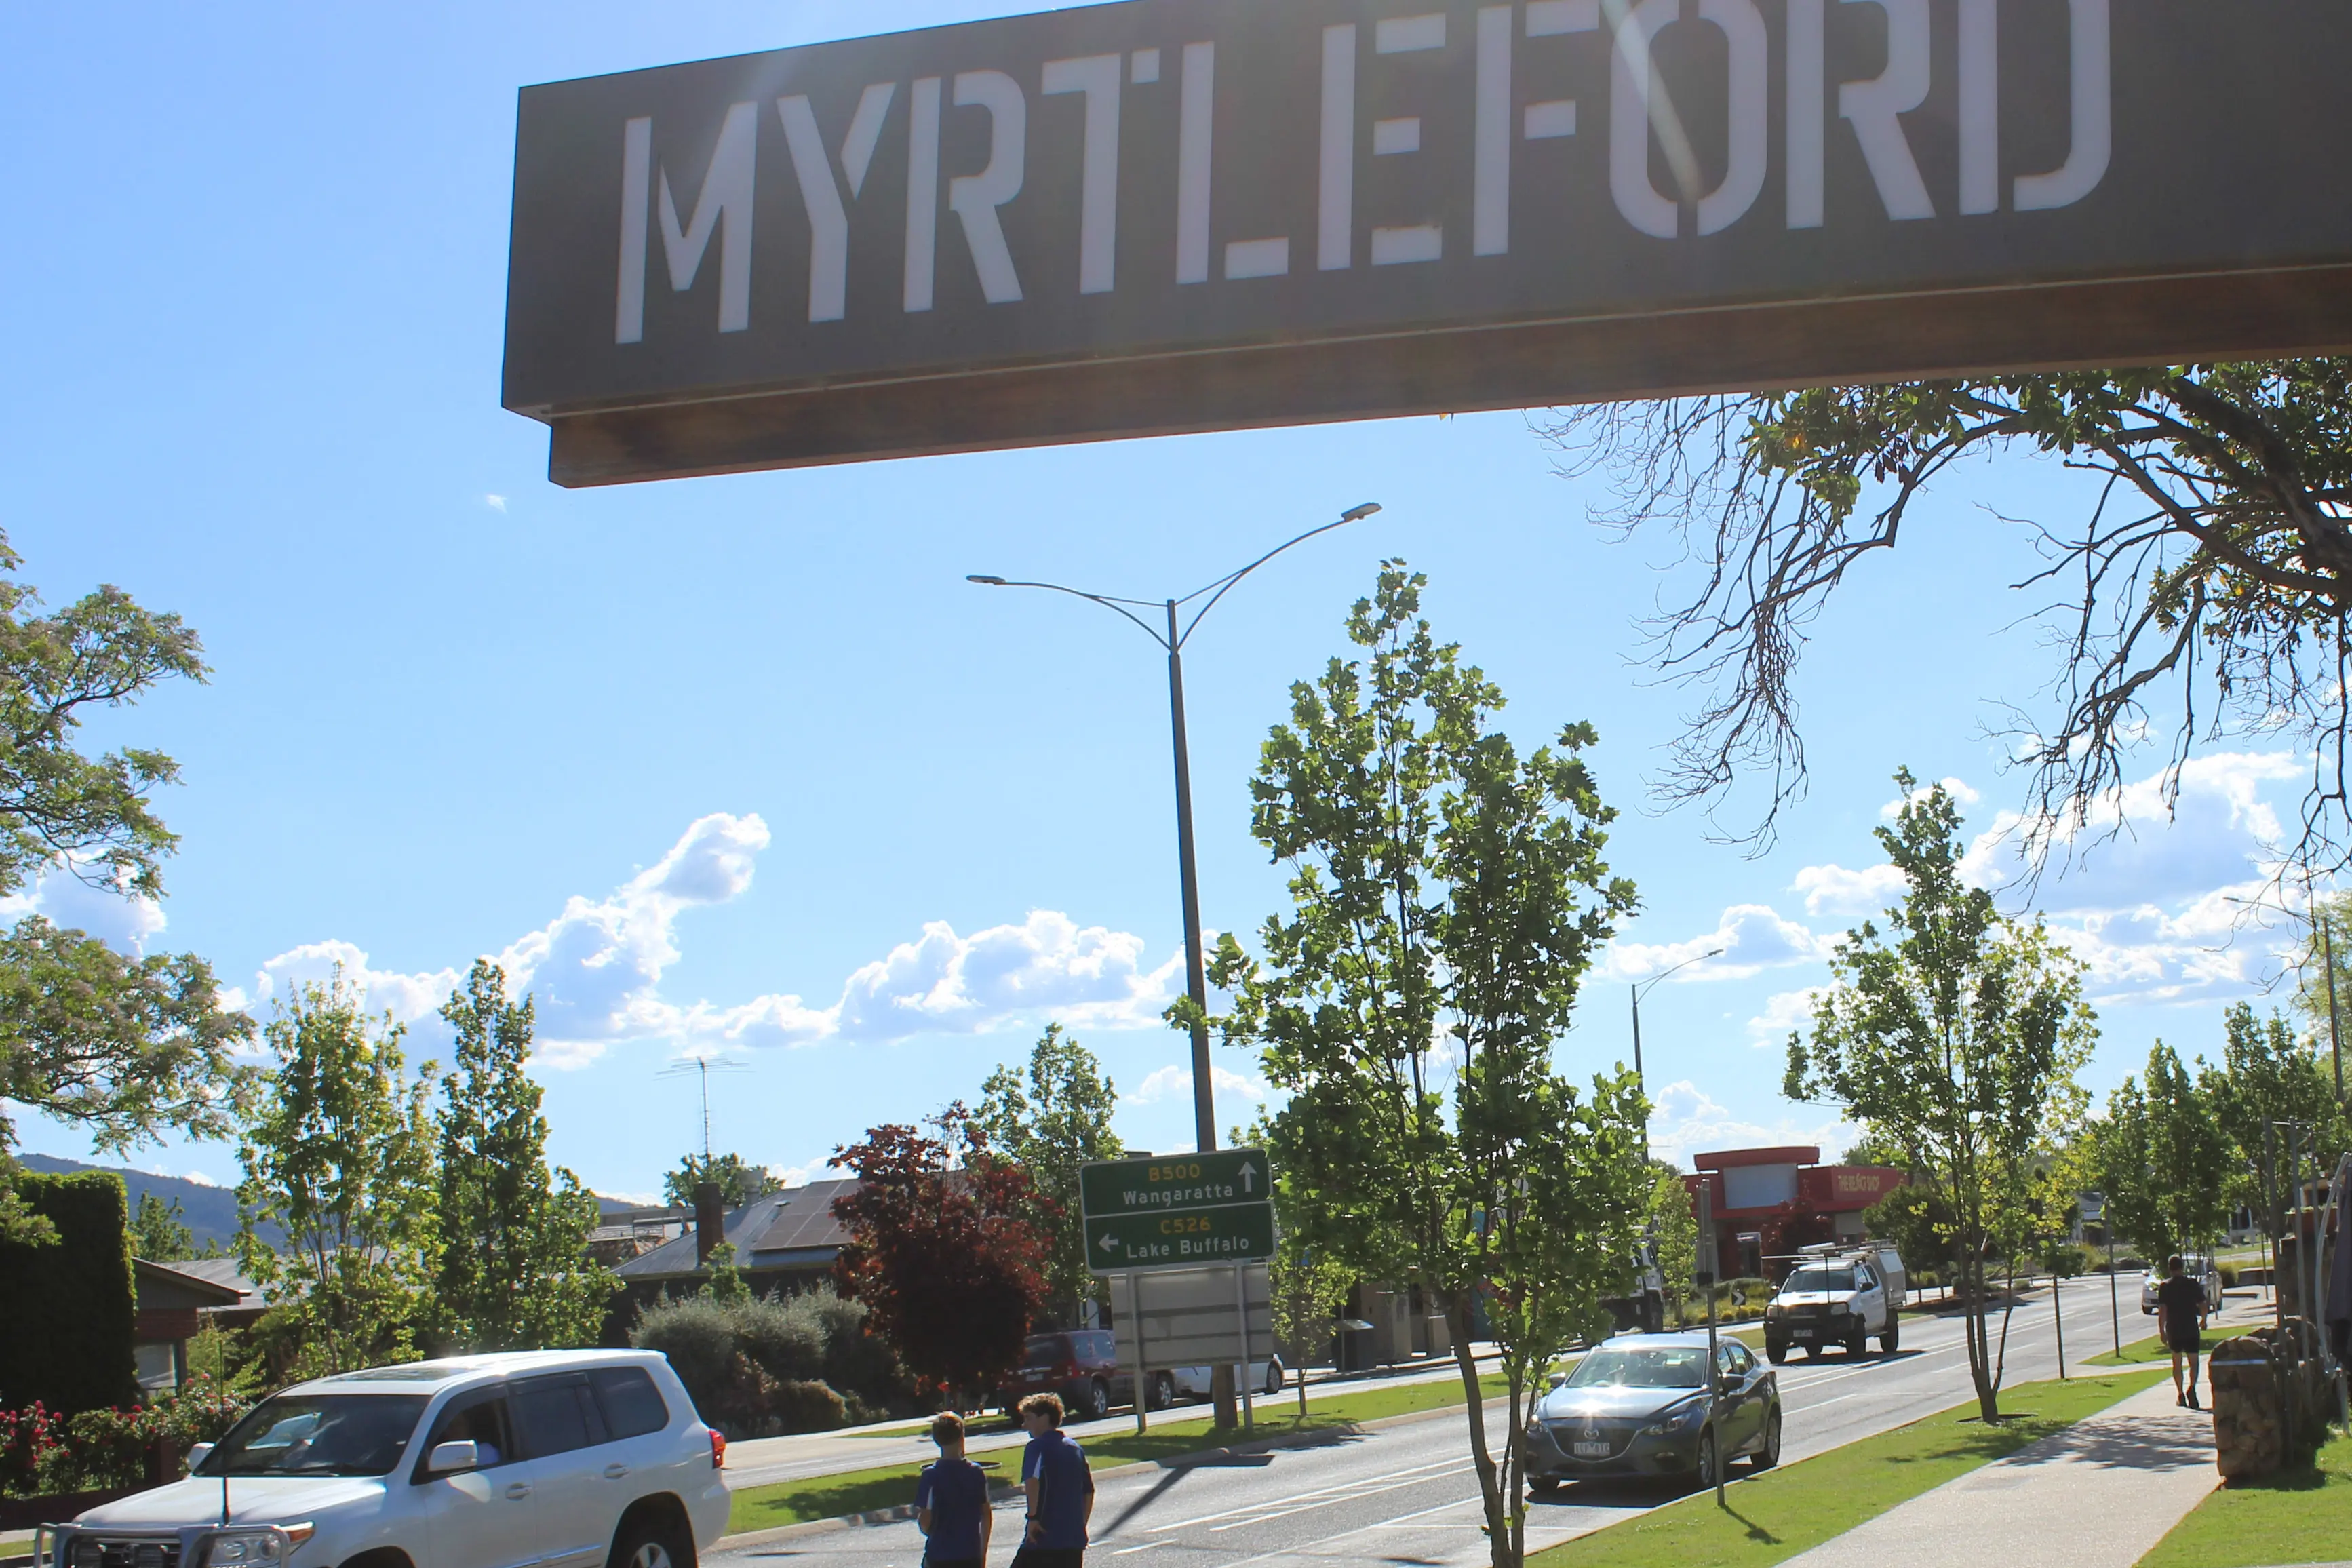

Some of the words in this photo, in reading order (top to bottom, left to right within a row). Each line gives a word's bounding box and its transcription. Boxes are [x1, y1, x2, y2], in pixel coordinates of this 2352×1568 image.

[615, 0, 2112, 344] MYRTLEFORD
[1148, 1163, 1200, 1181] B500
[1123, 1184, 1233, 1207] Wangaratta
[1160, 1217, 1211, 1234] C526
[1126, 1241, 1170, 1258] Lake
[1180, 1236, 1249, 1255] Buffalo
